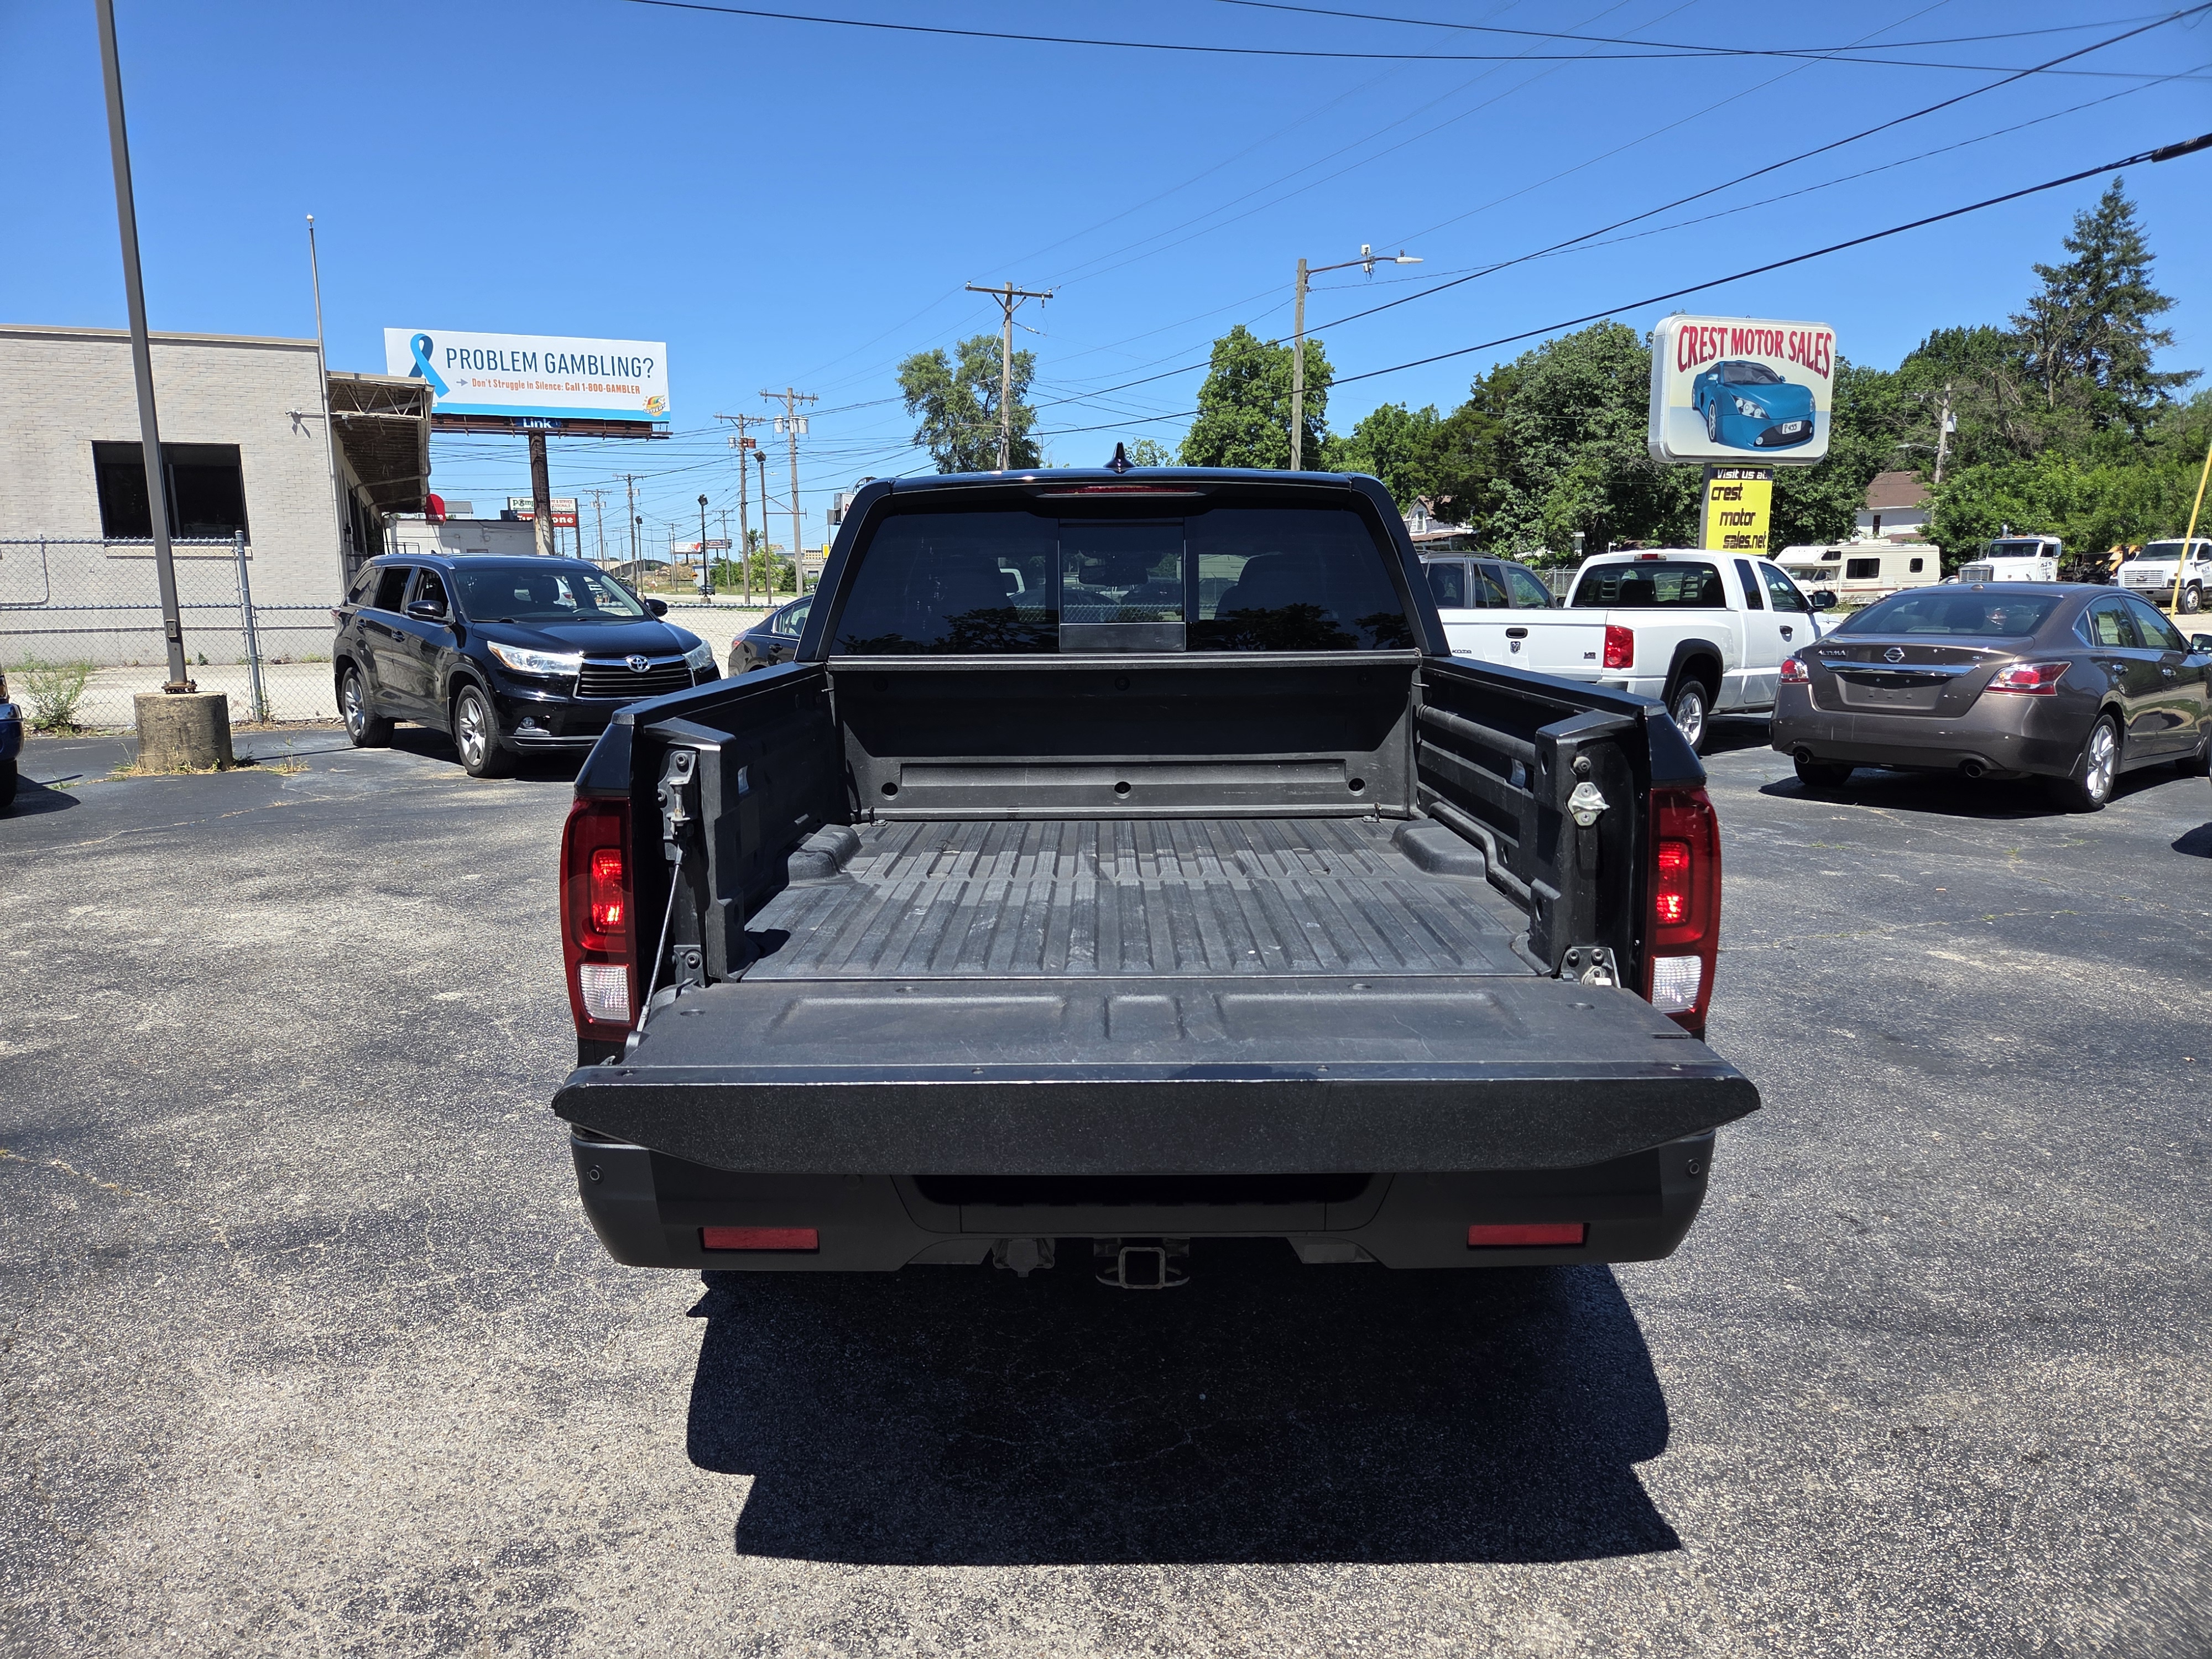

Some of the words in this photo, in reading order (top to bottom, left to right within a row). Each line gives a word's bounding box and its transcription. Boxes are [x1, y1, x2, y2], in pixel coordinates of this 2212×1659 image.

[1677, 325, 1728, 373] CREST
[1730, 328, 1785, 359] MOTOR
[1788, 331, 1832, 380] SALES
[446, 348, 538, 373] PROBLEM
[545, 352, 654, 378] GAMBLING?
[472, 378, 491, 388] Don't
[493, 379, 525, 390] Struggle
[535, 381, 564, 390] Silence:
[565, 382, 580, 391] Call
[581, 383, 640, 394] 1-800-GAMBLER
[643, 402, 666, 414] LOTTERY
[1717, 469, 1739, 479] Visit
[1741, 470, 1755, 479] us
[1711, 482, 1743, 500] crest
[1719, 508, 1756, 526] motor
[1723, 531, 1767, 549] sales.net
